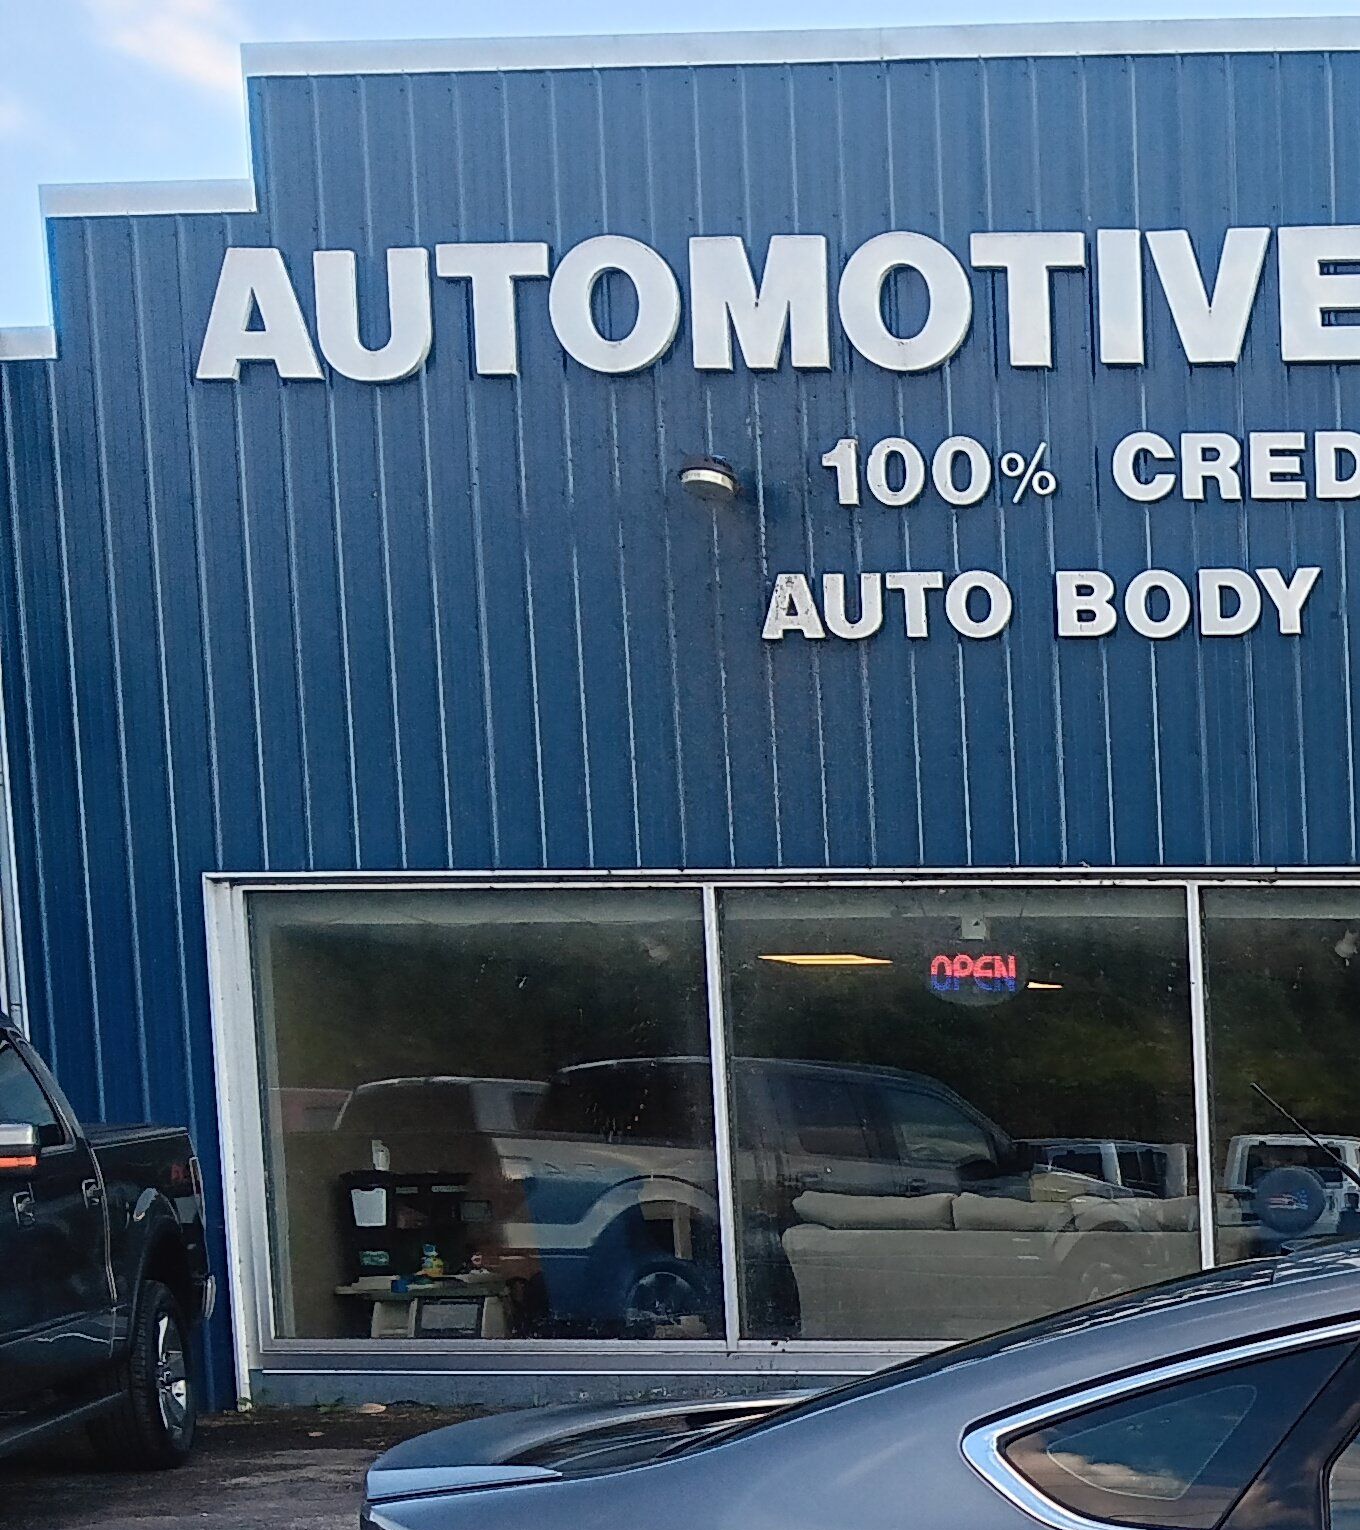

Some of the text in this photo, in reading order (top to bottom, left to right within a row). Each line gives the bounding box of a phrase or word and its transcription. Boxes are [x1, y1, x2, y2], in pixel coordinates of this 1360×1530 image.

[820, 434, 1057, 507] 100%
[761, 569, 1013, 641] AUTO
[1054, 566, 1323, 639] BODY
[930, 954, 1016, 991] OPEN
